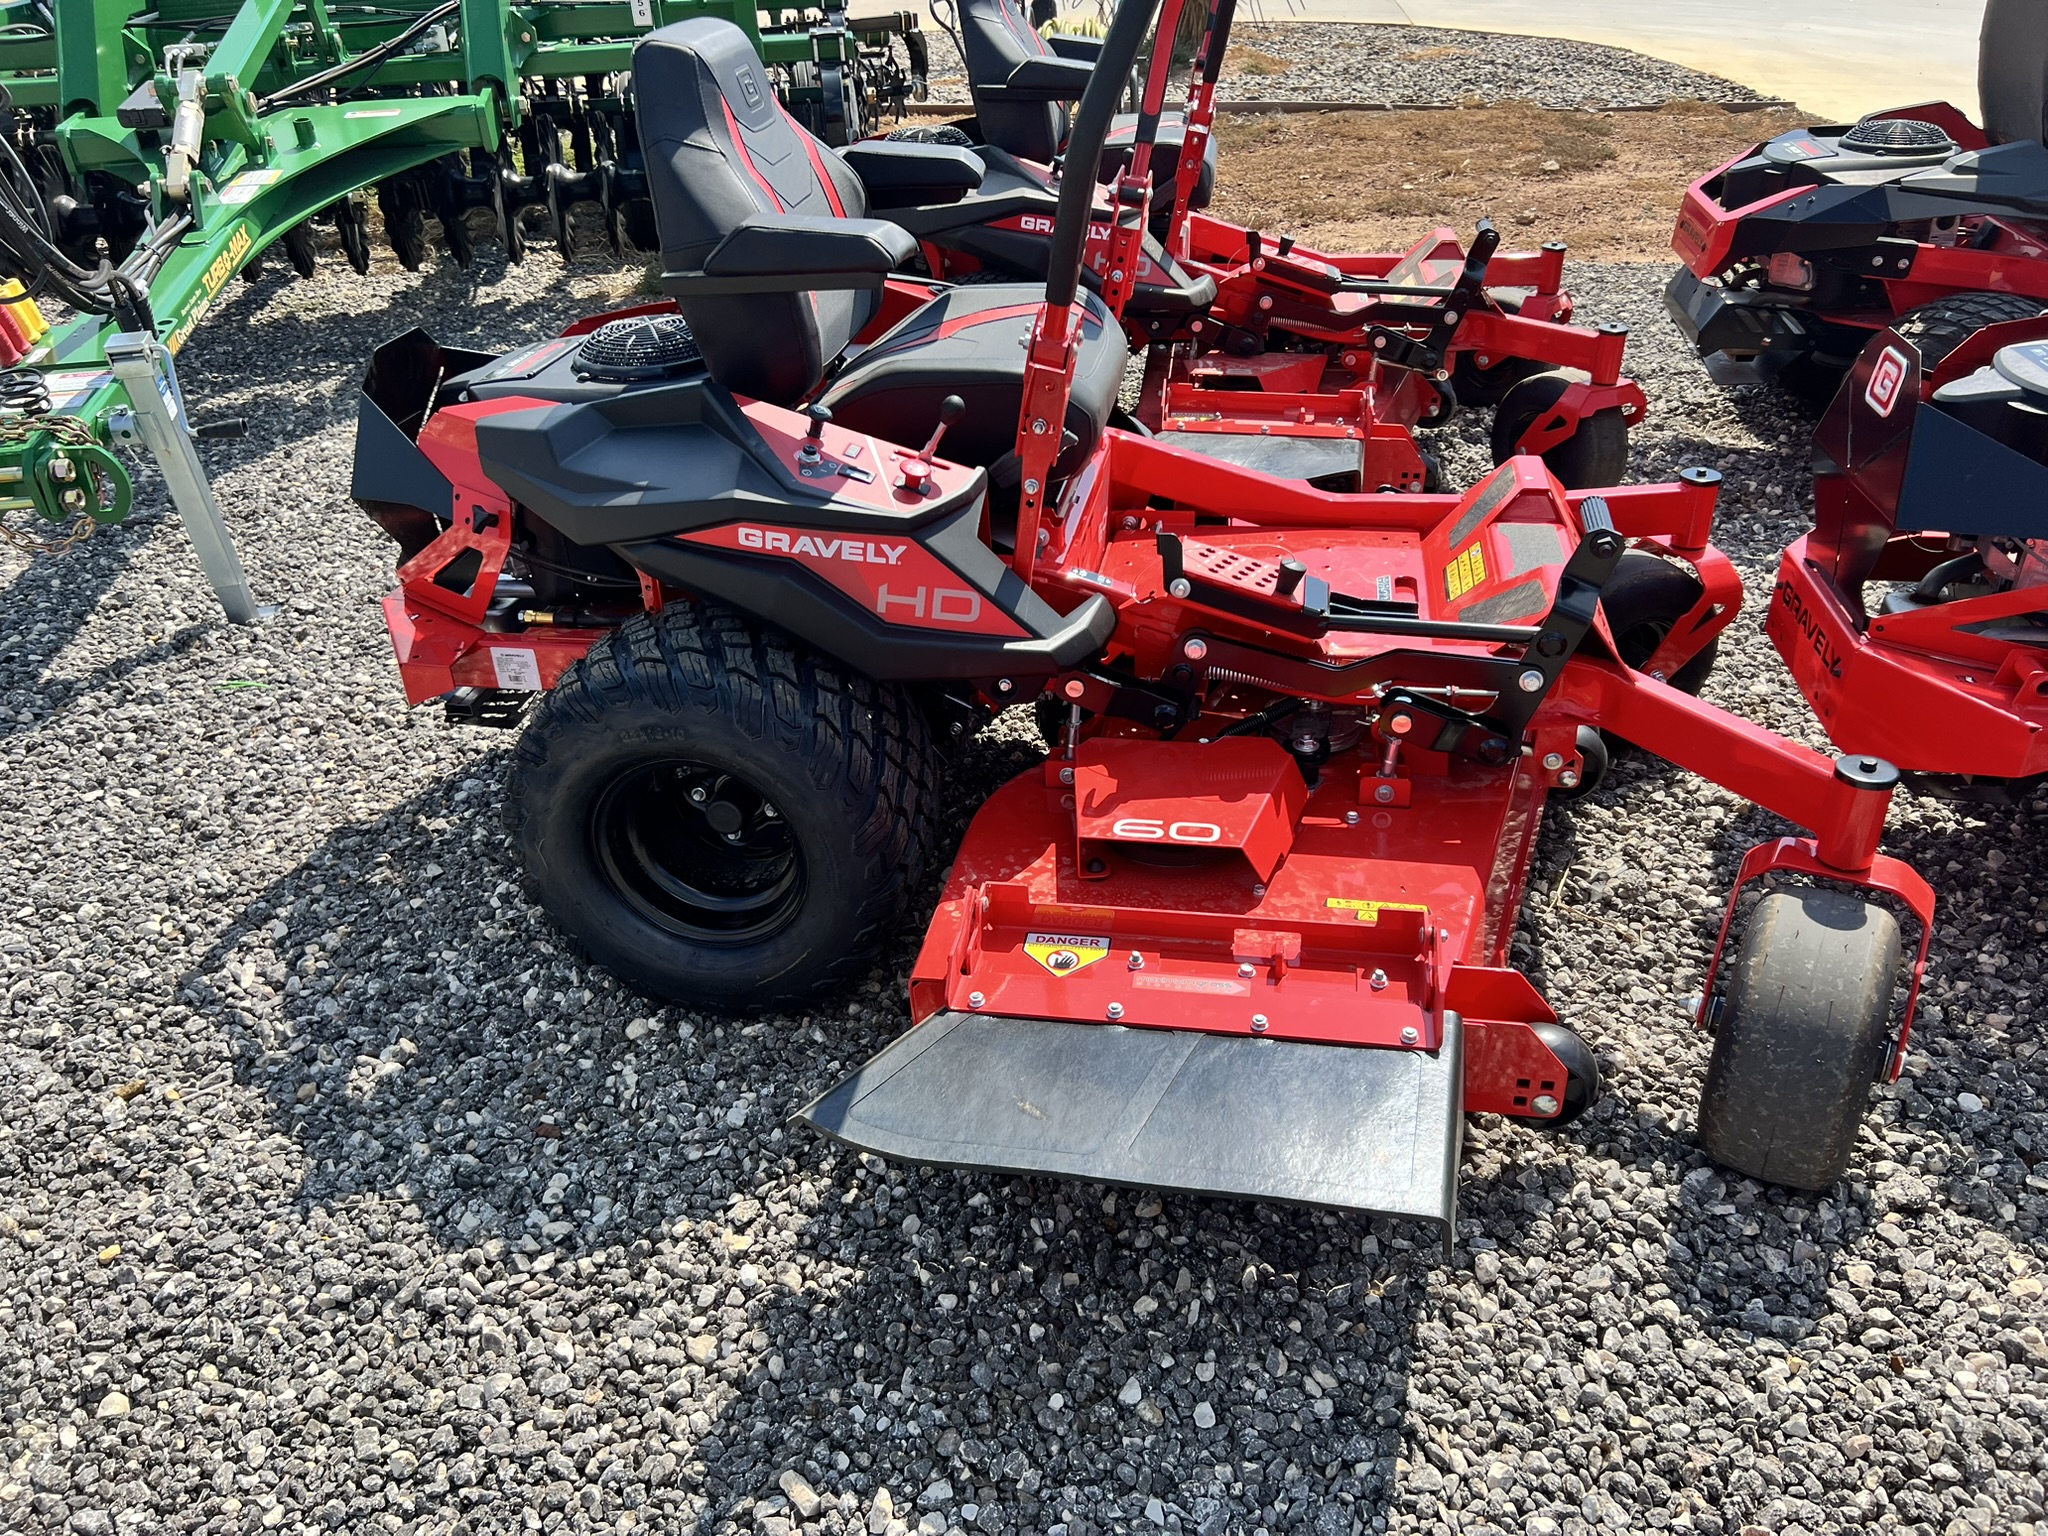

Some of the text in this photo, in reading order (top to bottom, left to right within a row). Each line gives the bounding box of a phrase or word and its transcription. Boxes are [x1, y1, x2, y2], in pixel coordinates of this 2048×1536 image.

[6, 208, 29, 234] Winner
[1020, 216, 1111, 241] GRLY
[176, 315, 197, 345] Great
[190, 297, 210, 324] Plains
[738, 527, 907, 565] GRAVELY
[877, 583, 981, 622] HD
[1783, 580, 1841, 674] GRAVELY
[1112, 818, 1221, 842] 60
[1035, 935, 1101, 947] DANGER
